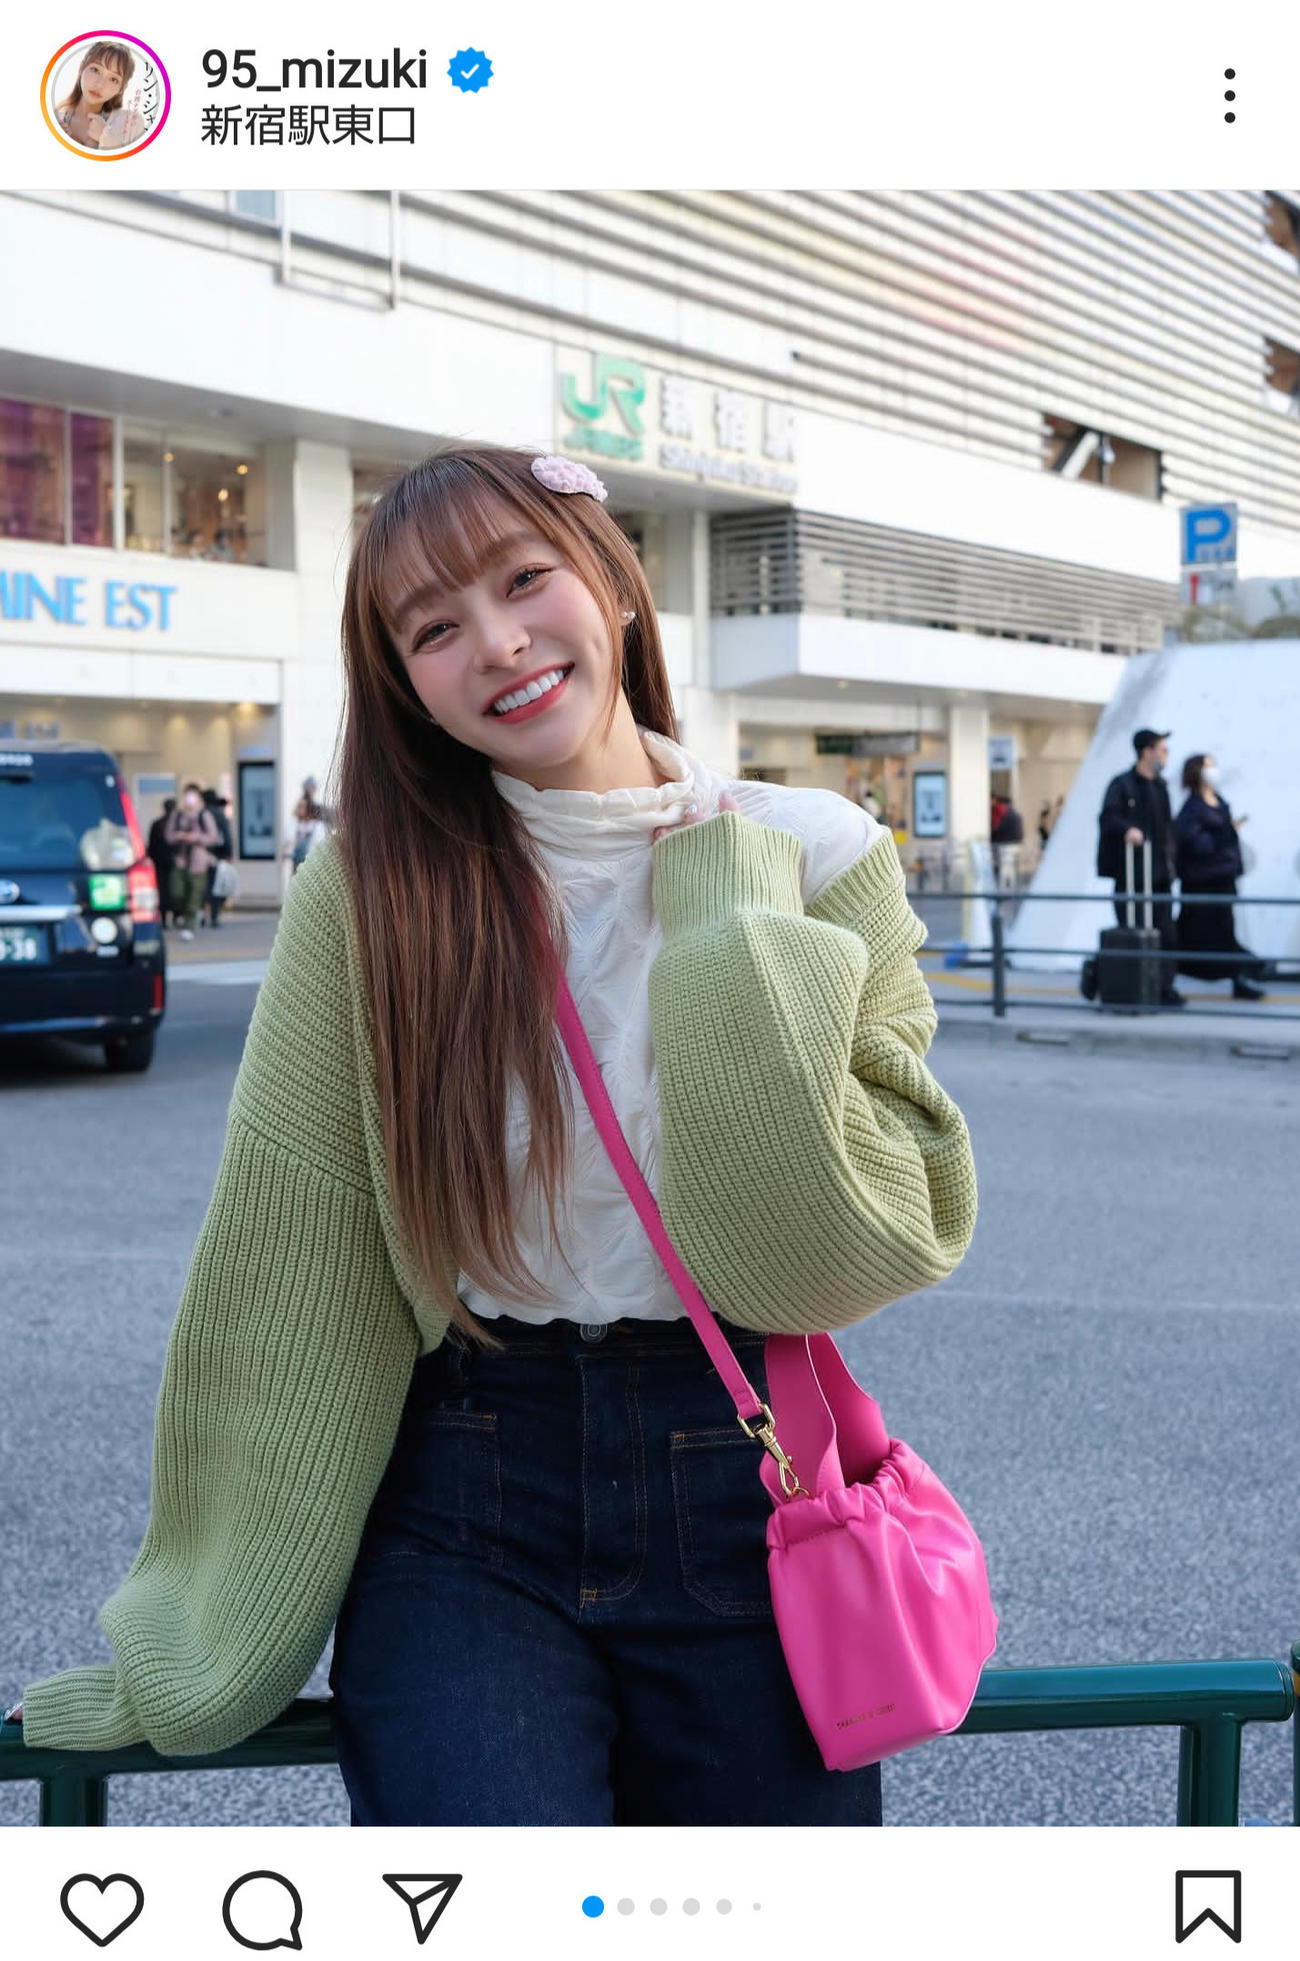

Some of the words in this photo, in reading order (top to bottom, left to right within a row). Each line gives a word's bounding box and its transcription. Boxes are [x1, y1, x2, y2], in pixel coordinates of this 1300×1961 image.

[560, 354, 646, 436] JR
[1185, 509, 1231, 564] P
[104, 579, 178, 632] EST
